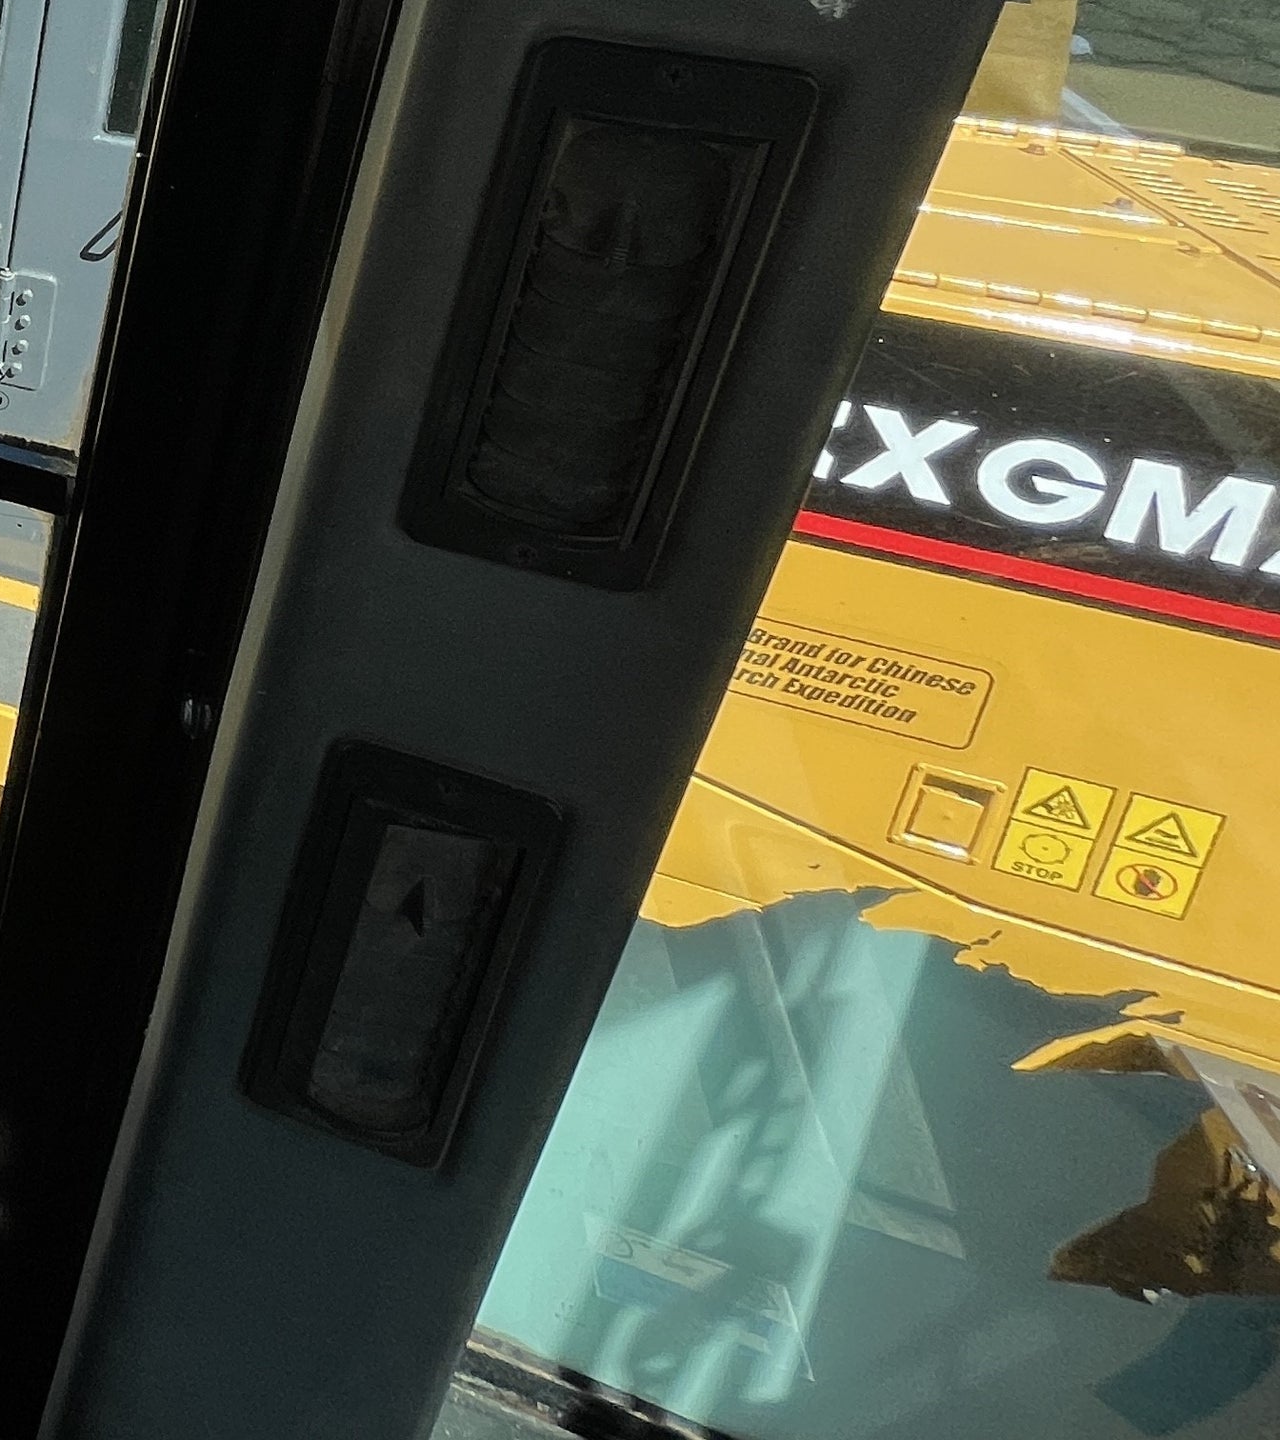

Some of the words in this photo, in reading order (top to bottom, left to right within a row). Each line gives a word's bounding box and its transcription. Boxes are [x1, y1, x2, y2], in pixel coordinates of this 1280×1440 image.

[841, 403, 1280, 574] XGM
[747, 628, 827, 658] Brand
[824, 647, 867, 667] for
[866, 657, 977, 696] Chinese
[779, 657, 901, 699] Antarctic
[781, 678, 918, 724] Expedition
[1011, 861, 1064, 880] STOP
